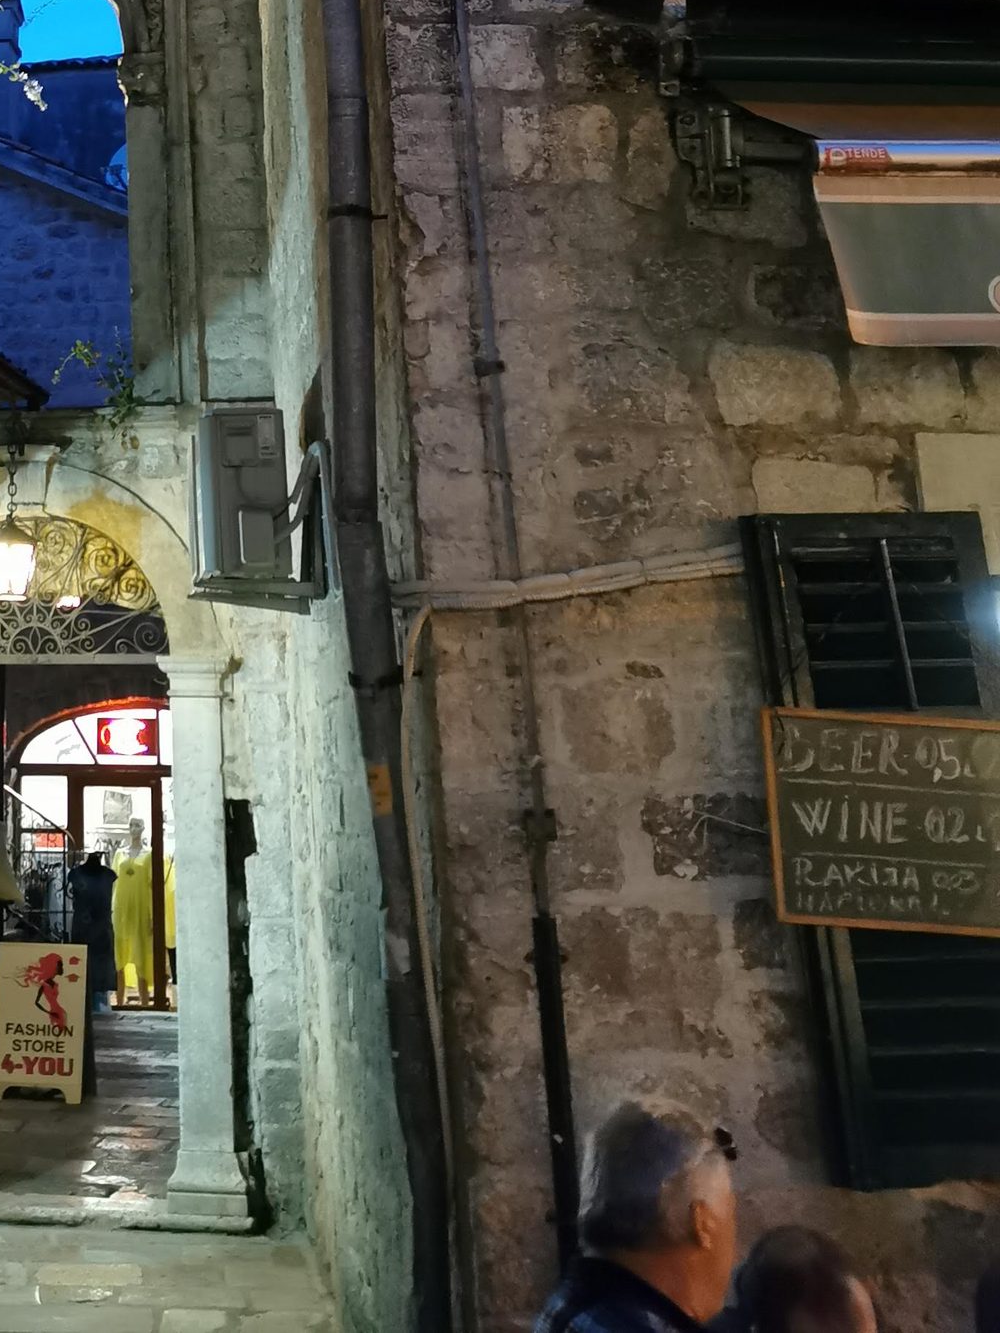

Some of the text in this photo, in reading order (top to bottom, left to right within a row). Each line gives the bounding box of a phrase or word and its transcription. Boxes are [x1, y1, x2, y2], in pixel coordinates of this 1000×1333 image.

[5, 1022, 74, 1037] FASHION
[12, 1039, 66, 1053] STORE
[1, 1053, 74, 1076] 4-YOU
